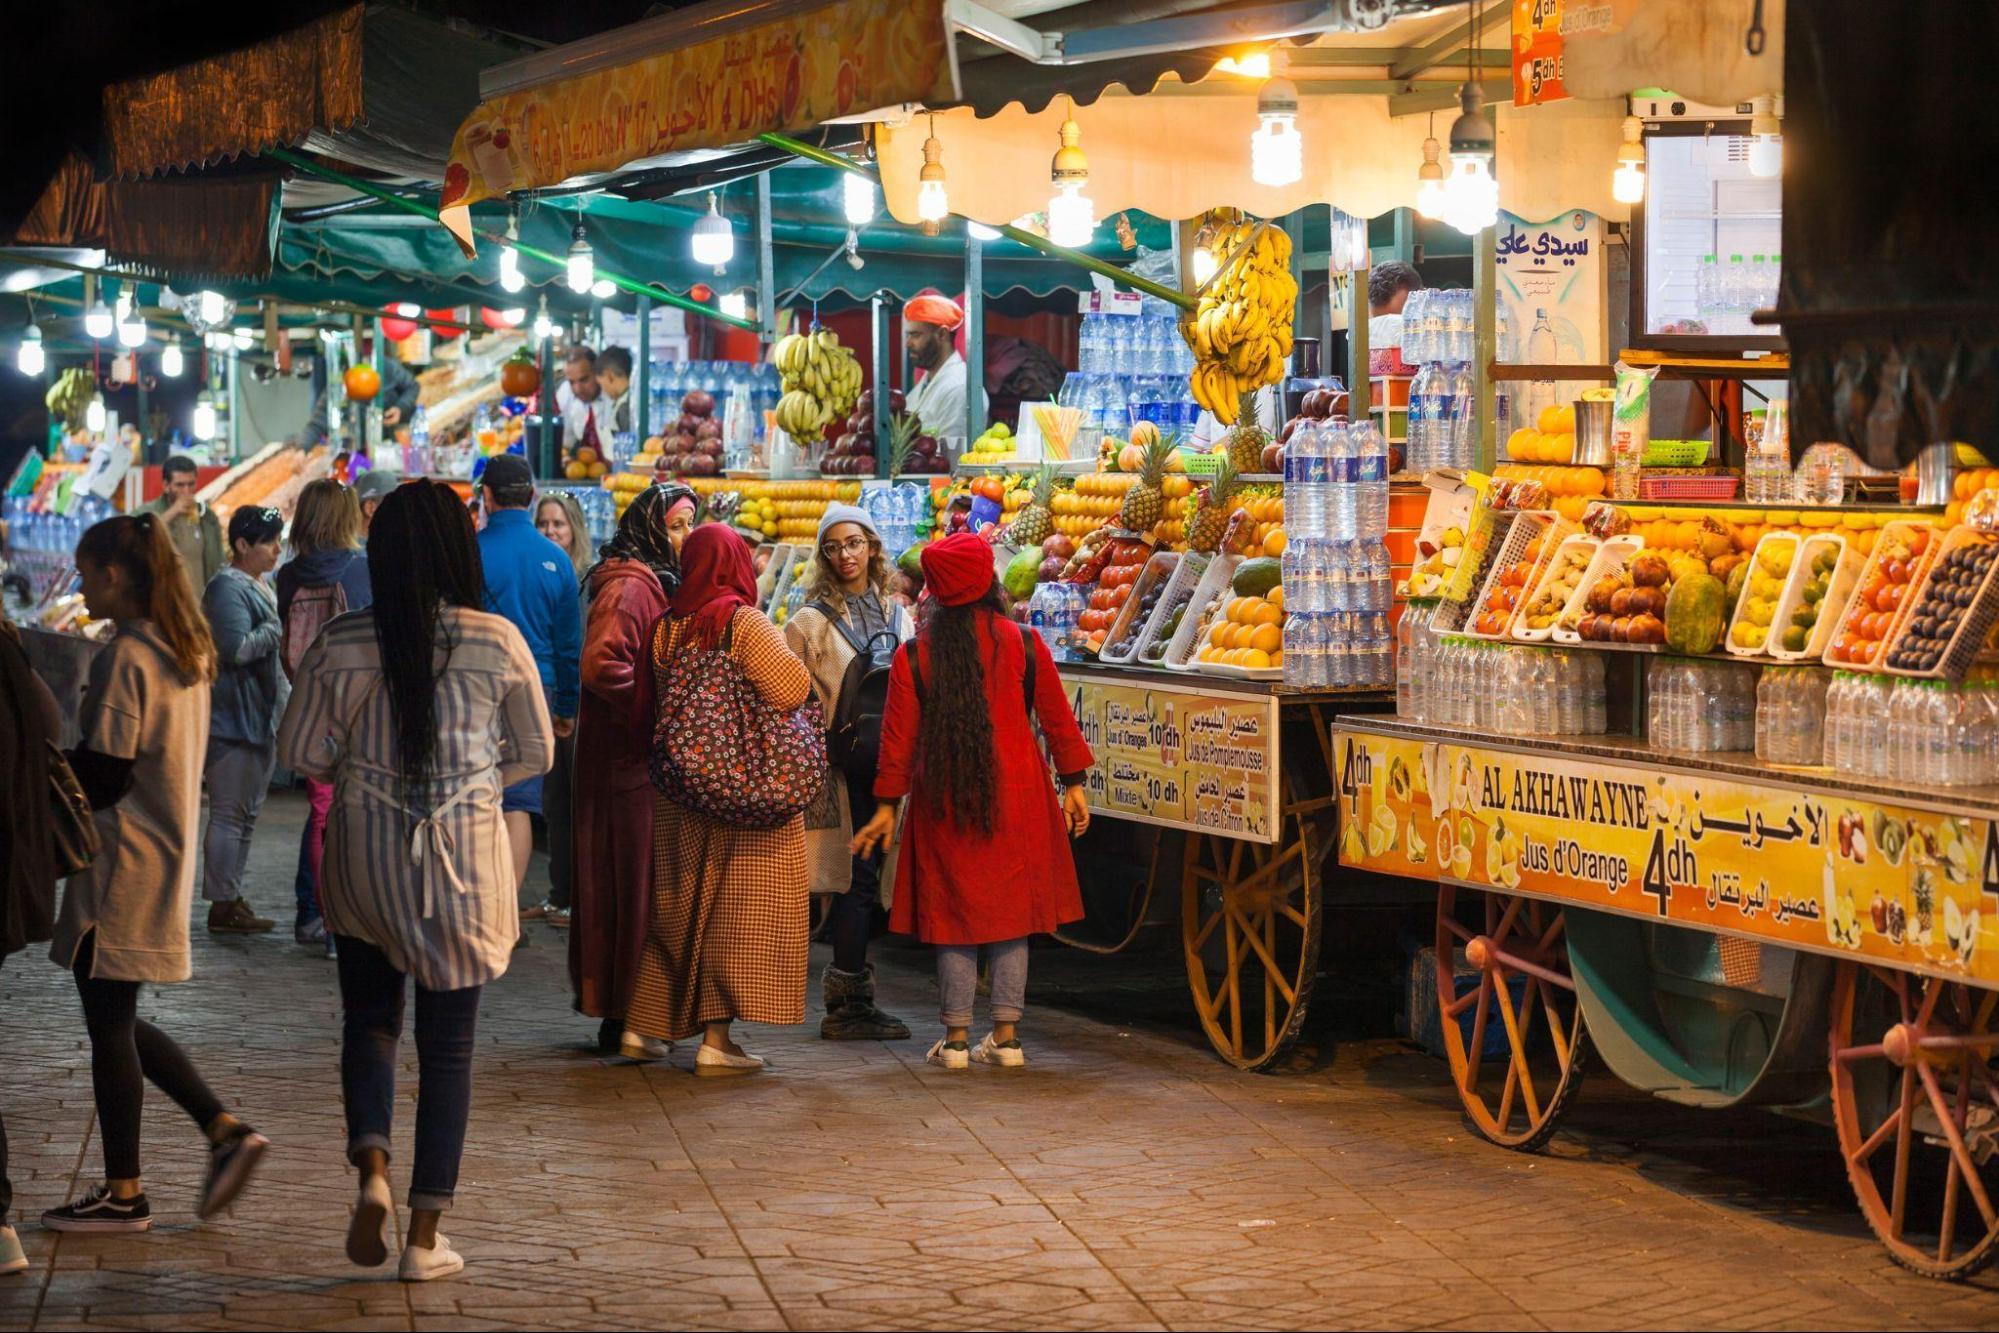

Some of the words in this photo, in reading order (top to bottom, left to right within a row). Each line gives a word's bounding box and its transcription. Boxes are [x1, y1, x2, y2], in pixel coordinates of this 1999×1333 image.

[1496, 224, 1529, 265] علي
[1532, 232, 1588, 266] سيدي
[1149, 724, 1161, 745] 10
[1166, 726, 1179, 747] dh
[1189, 737, 1199, 761] Jus
[1201, 744, 1208, 762] de
[1210, 741, 1262, 772] Pomplemousse
[1115, 787, 1137, 805] Mixte
[1148, 779, 1160, 800] 10
[1164, 782, 1178, 803] dh
[1481, 766, 1506, 808] AL
[1511, 769, 1648, 830] AKHAWAYNE
[1522, 836, 1548, 871] Jus
[1554, 841, 1627, 891] d'Orange
[1707, 873, 1769, 917] البرتقال
[1774, 899, 1819, 922] عصير
